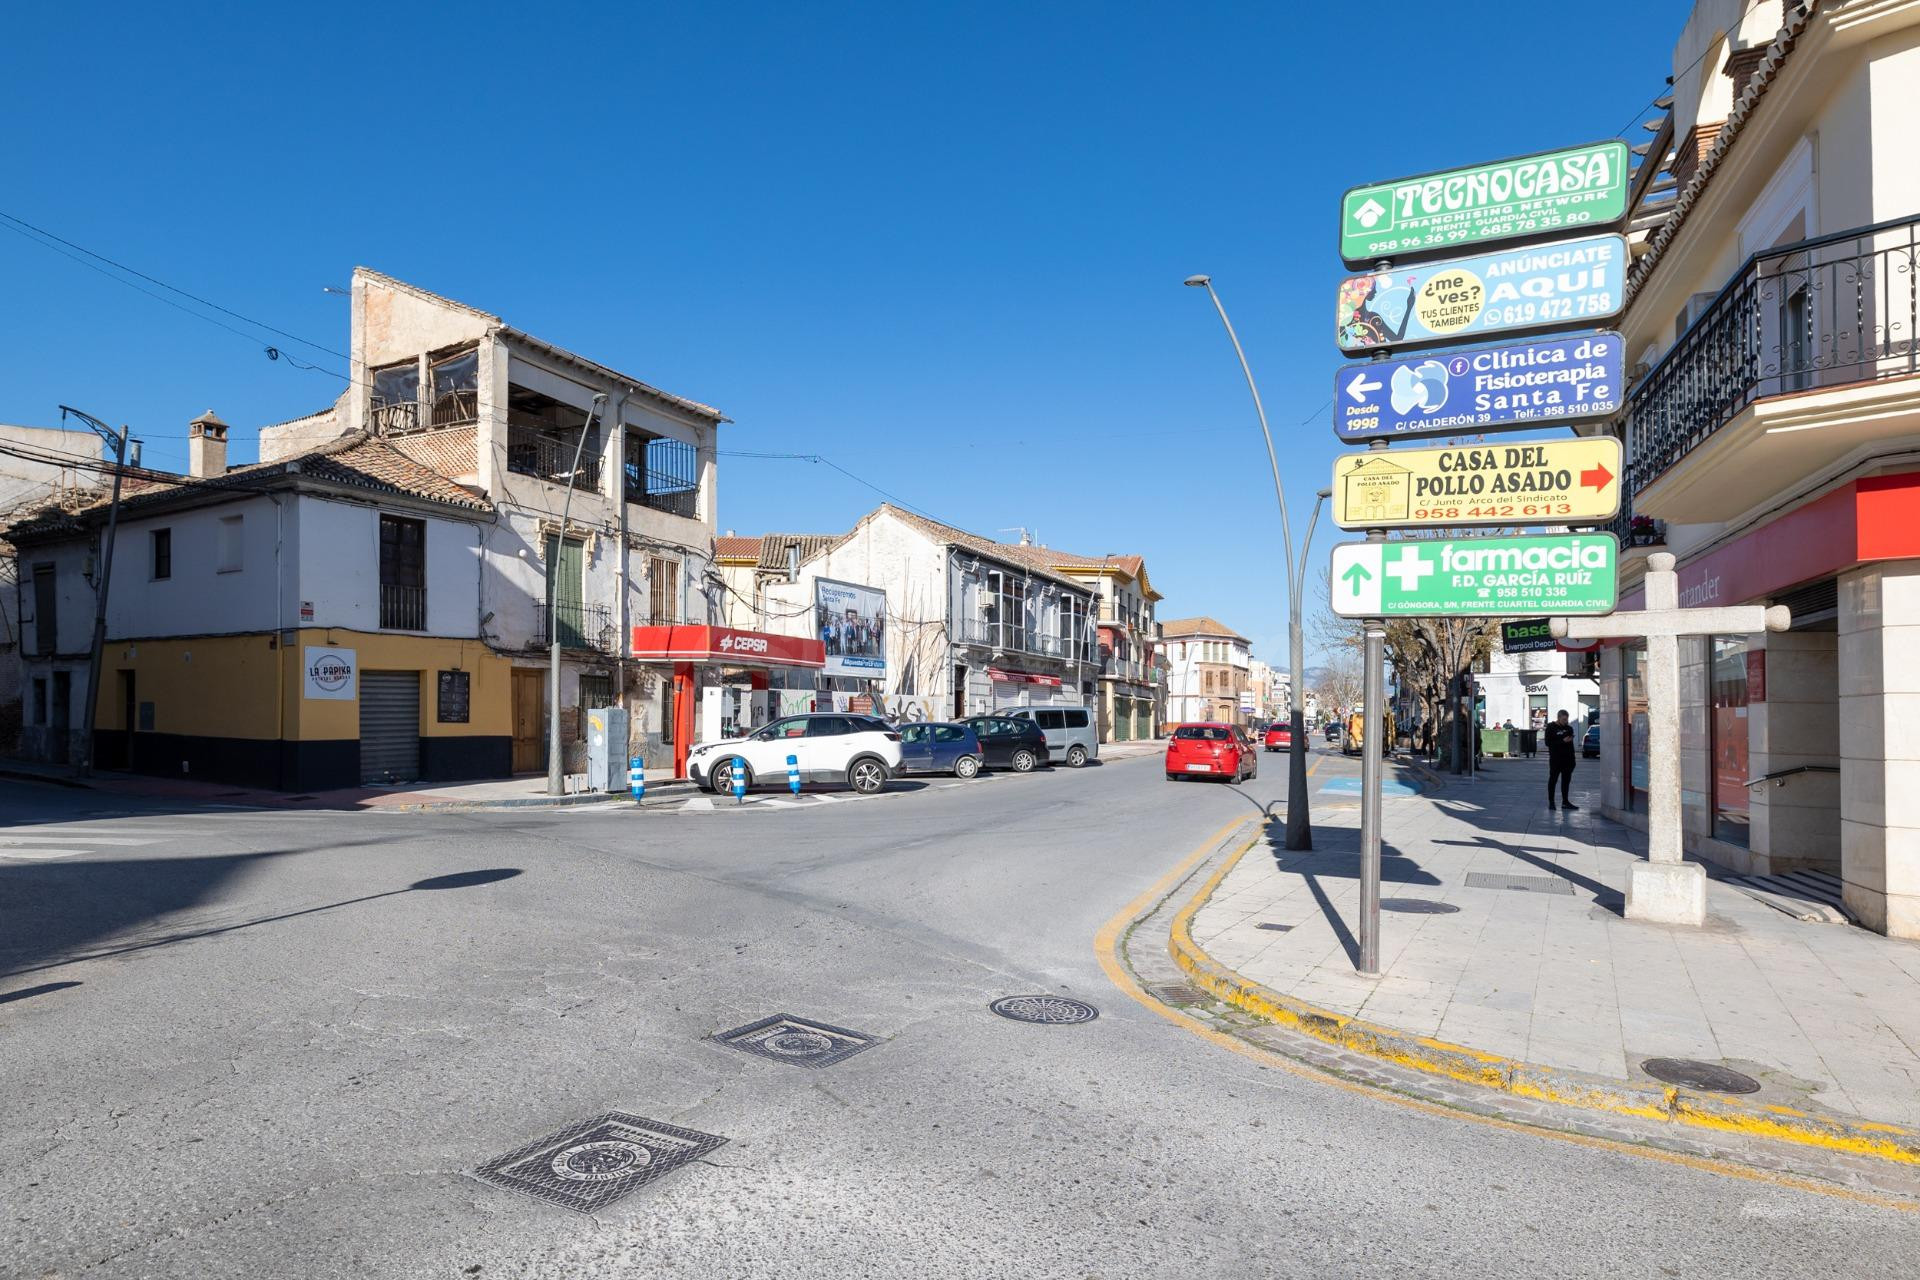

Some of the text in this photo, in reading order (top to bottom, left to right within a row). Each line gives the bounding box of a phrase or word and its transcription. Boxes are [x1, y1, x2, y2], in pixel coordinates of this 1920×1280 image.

[1396, 153, 1610, 218] TECNOCASA
[1400, 191, 1608, 230] FRANCHISING NETWORK
[1430, 207, 1560, 233] FRENTE GUARDIA CIVIL
[1368, 239, 1398, 253] 958
[1401, 236, 1420, 248] 96
[1424, 232, 1444, 245] 36
[1447, 229, 1467, 241] 99
[1480, 222, 1511, 236] 685
[1515, 218, 1536, 231] 78
[1541, 214, 1562, 227] 35
[1566, 210, 1591, 224] 80
[1486, 245, 1612, 279] ANÚNCIATE
[1424, 276, 1464, 298] ¿me
[1437, 285, 1481, 305] ves?
[1488, 266, 1606, 304] AQUÍ
[1421, 302, 1480, 319] TUS CLIENTES
[1503, 292, 1611, 324] 619 472 758
[1472, 341, 1608, 372] Clínica de
[1475, 363, 1607, 393] Fisioterapia
[1475, 382, 1610, 412] Santa Fe
[1346, 404, 1379, 416] Desde
[1395, 421, 1407, 431] C/
[1409, 415, 1474, 430] CALDERÓN
[1477, 413, 1491, 423] 39
[1513, 408, 1542, 420] Telf.:
[1544, 406, 1564, 416] 958
[1568, 403, 1588, 414] 510
[1592, 400, 1614, 411] 035
[1346, 418, 1379, 431] 1998
[1438, 446, 1549, 472] CASA DEL
[1416, 470, 1572, 497] POLLO ASADO
[1415, 503, 1571, 520] 958 442 613
[1419, 499, 1430, 507] C/
[1433, 498, 1462, 507] Junto
[1496, 496, 1513, 505] del
[1516, 494, 1568, 504] Sindicato
[1440, 540, 1607, 572] farmacia
[1452, 569, 1592, 588] F.D. GARCÍA RUÍZ
[1461, 601, 1496, 609] FRENTE
[1497, 600, 1538, 608] CUARTEL
[1541, 599, 1584, 607] GUARDIA
[1586, 598, 1609, 607] CIVIL
[1497, 586, 1567, 598] 958 510 336
[1507, 624, 1549, 639] base
[733, 636, 768, 652] CEPSA
[1505, 643, 1534, 651] Liverpool
[310, 665, 352, 677] LA PAPIKA
